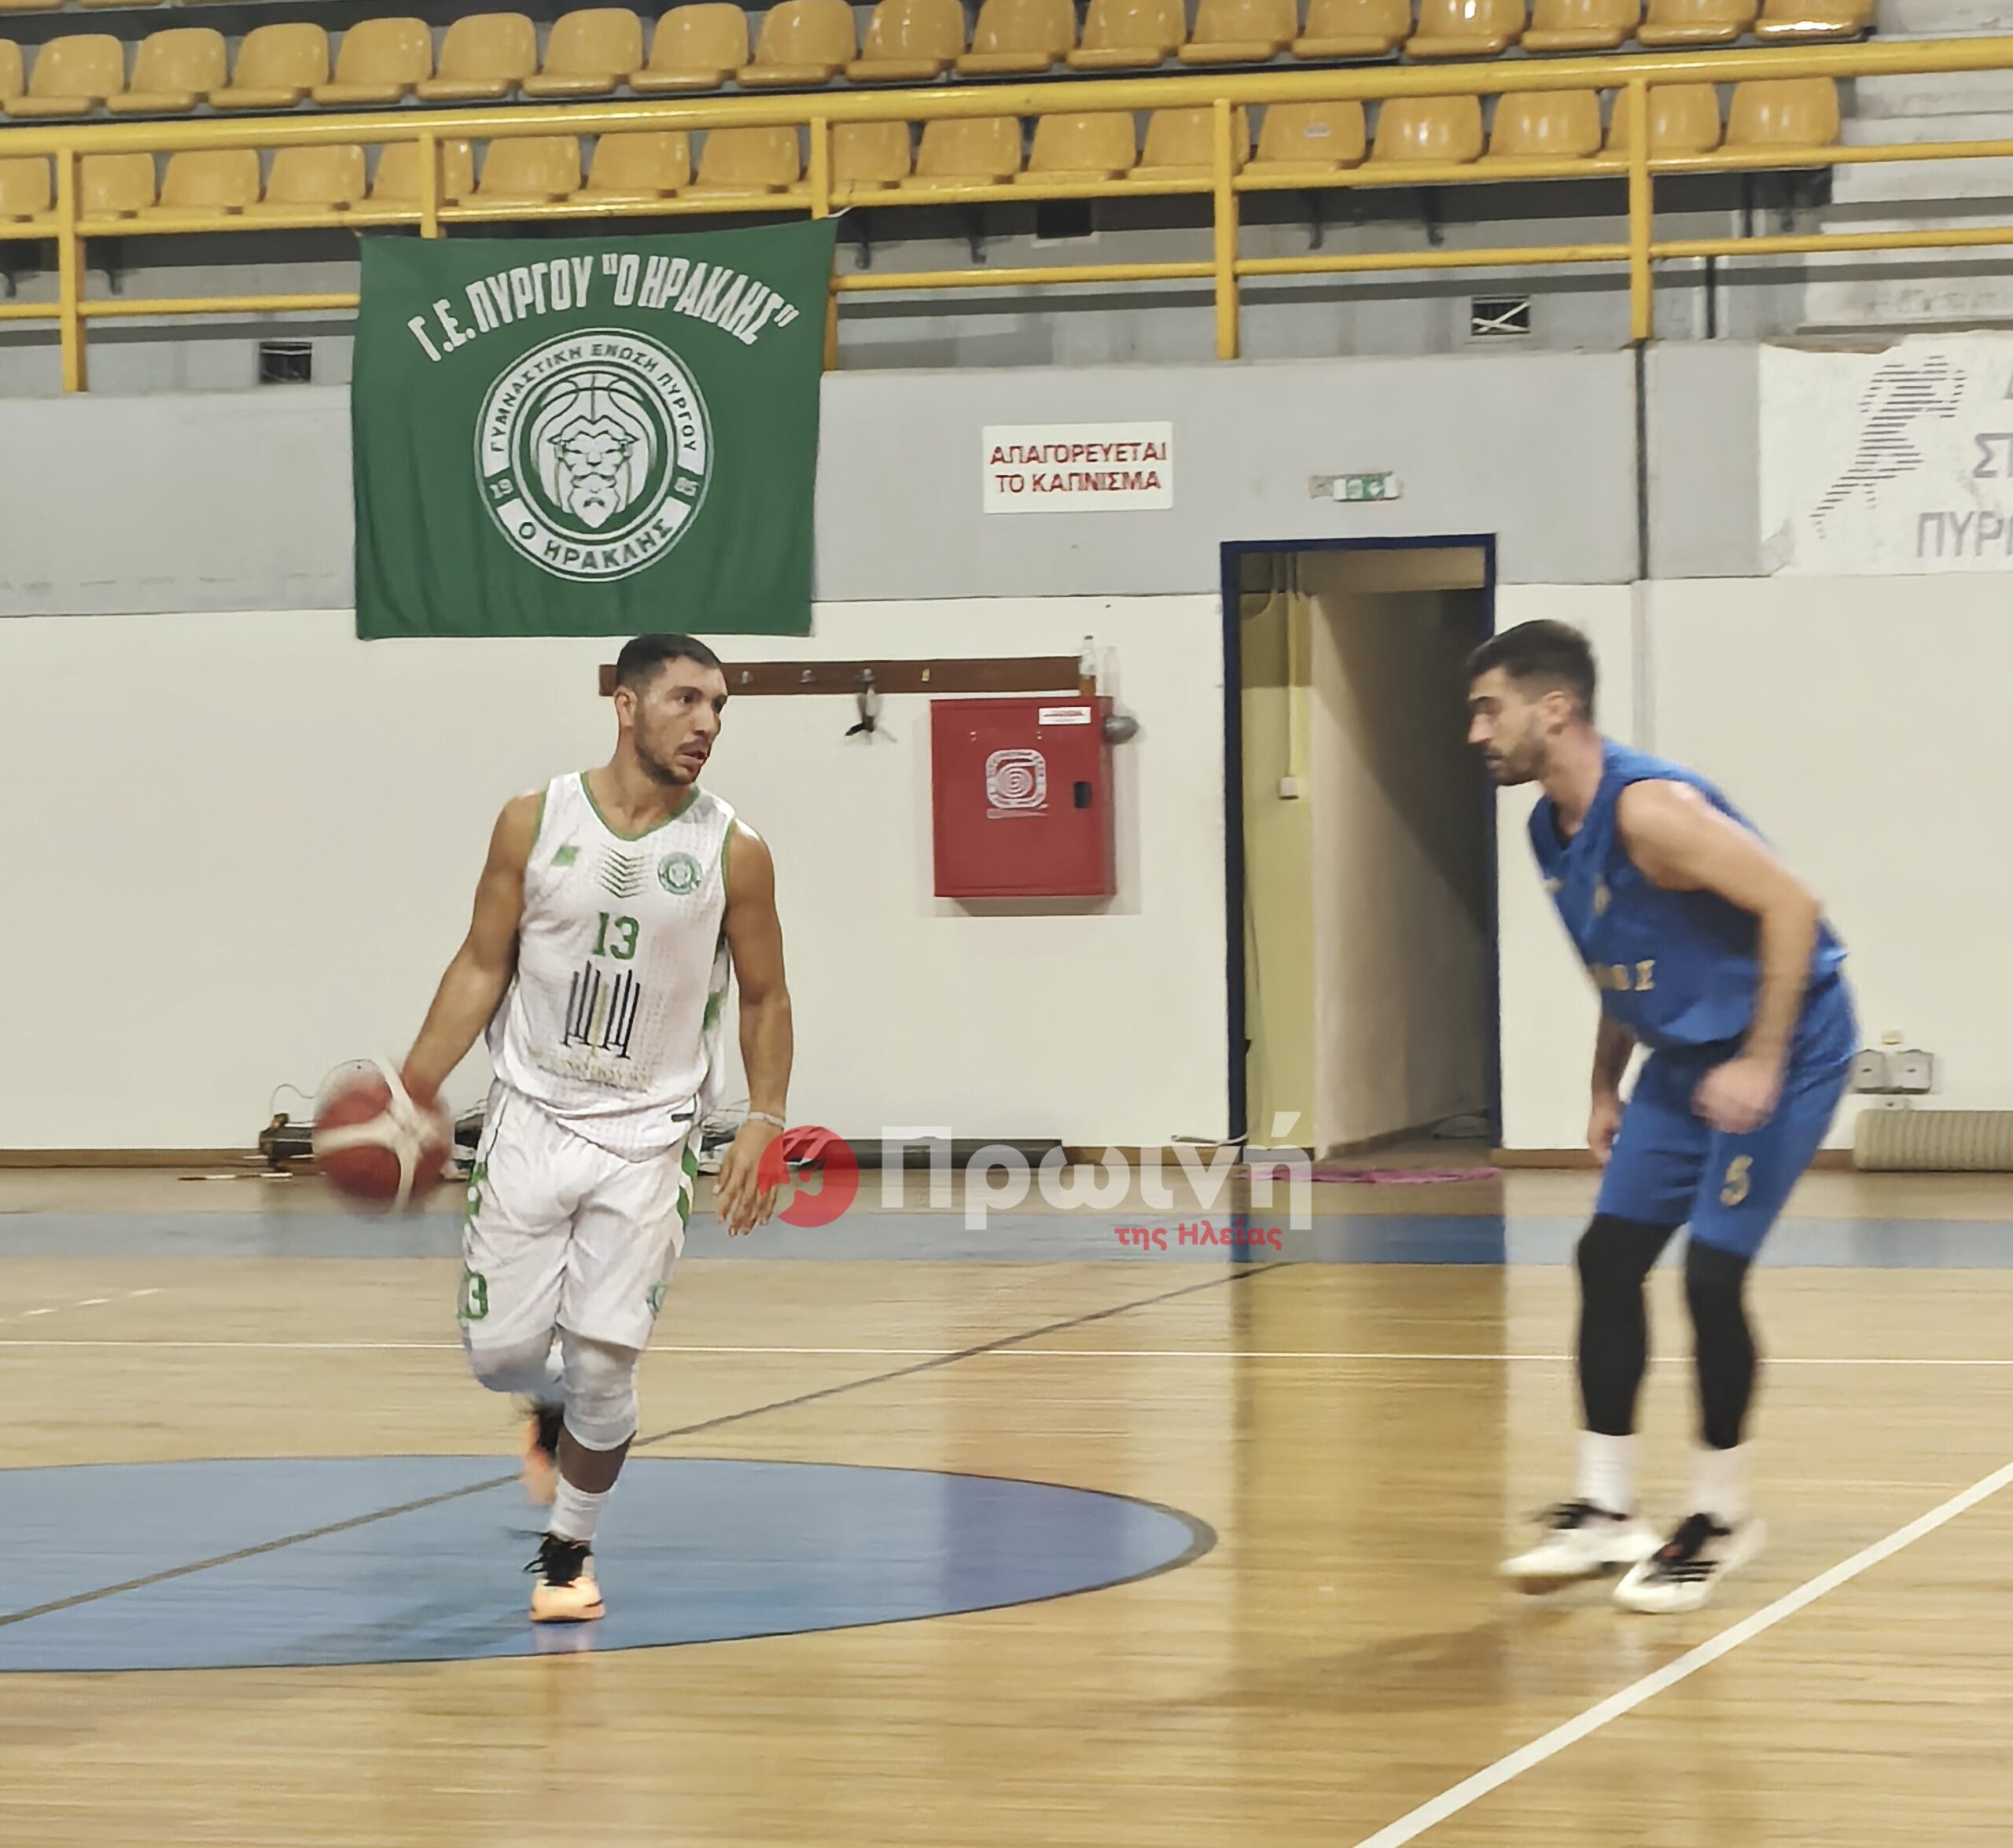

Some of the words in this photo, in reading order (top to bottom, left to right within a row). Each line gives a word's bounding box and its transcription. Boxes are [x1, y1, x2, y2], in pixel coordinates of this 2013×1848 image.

[491, 347, 582, 453] ΓΥΜΝΑΣΤΙΚΗ
[591, 344, 659, 373] ΕΝΩΣΗ
[657, 373, 697, 451] ΠΥΡΓΟΥ
[990, 441, 1167, 465] ΑΠΑΓΟΡΕΥΕΤΑΙ
[995, 473, 1024, 493] ΤΟ
[1032, 470, 1161, 492] ΚΑΠΝΙΣΜΑ
[519, 521, 536, 539] Ο
[543, 518, 673, 569] ΗΡΑΚΛΗΣ
[592, 911, 640, 960] 13
